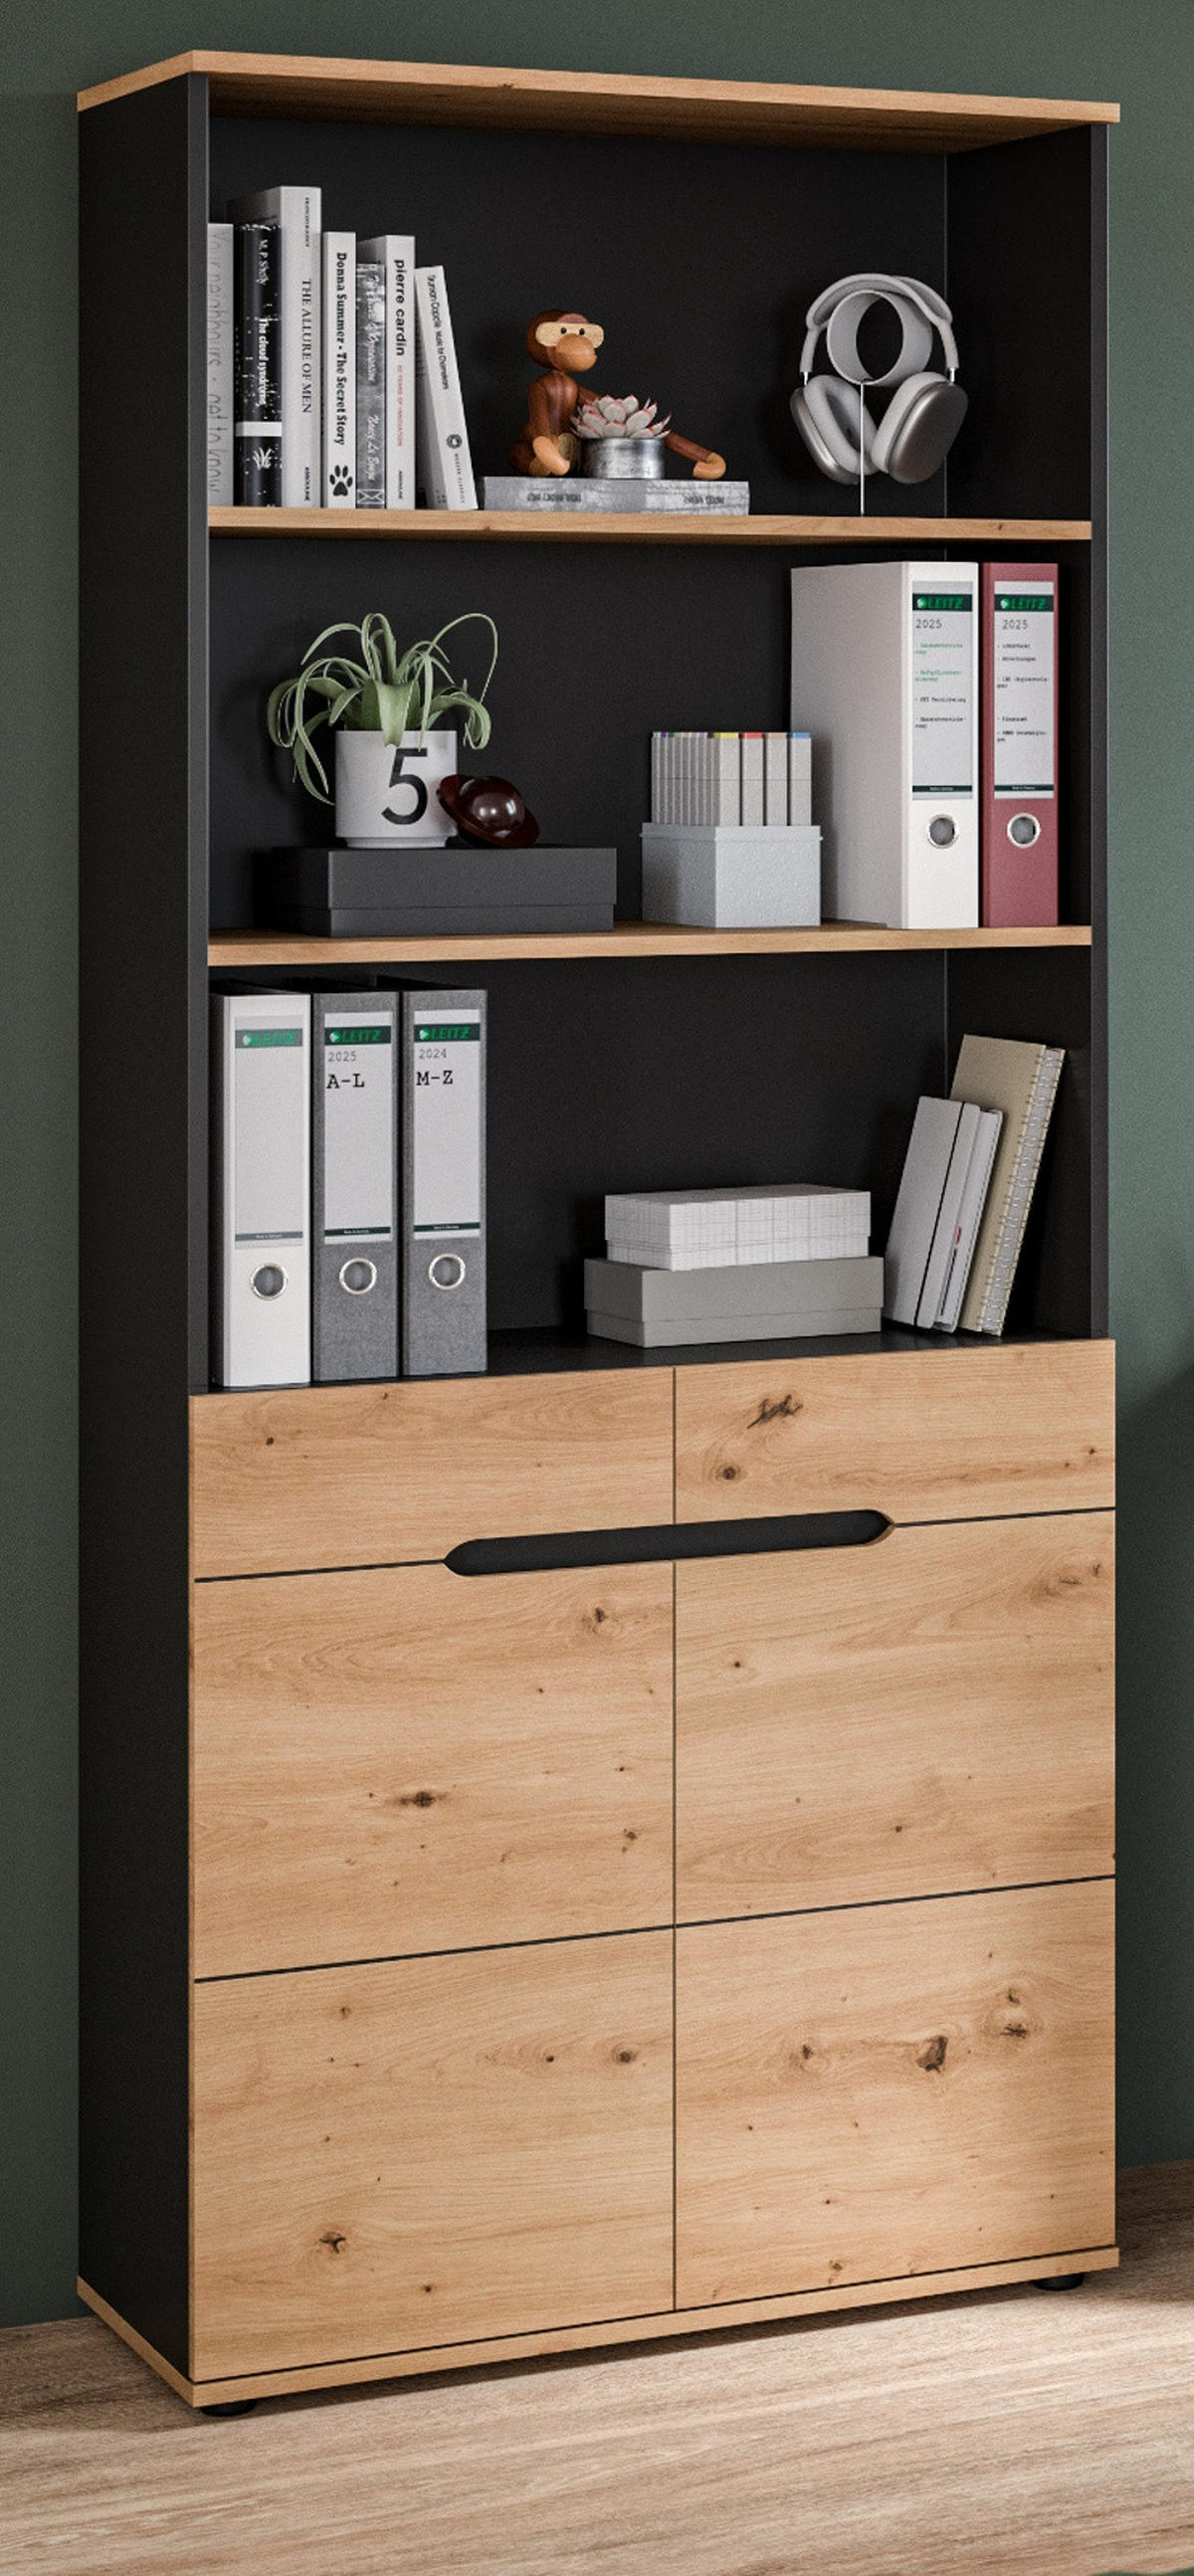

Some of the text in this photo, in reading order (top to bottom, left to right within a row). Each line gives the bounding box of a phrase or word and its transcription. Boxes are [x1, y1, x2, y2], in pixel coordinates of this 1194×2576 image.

[335, 252, 347, 292] Donna
[335, 294, 347, 343] Summer
[394, 259, 407, 356] pierre cardin
[259, 335, 270, 361] cloud
[301, 279, 311, 414] THE ALLURE OF MEN
[335, 351, 347, 375] The
[335, 376, 347, 414] Secret
[333, 415, 347, 446] Story
[914, 618, 943, 630] 2025
[1002, 619, 1029, 630] 2025
[381, 748, 428, 825] 5
[341, 1028, 382, 1043] LEITZ
[429, 1025, 471, 1040] LEITZ
[327, 1051, 357, 1063] 2025
[418, 1048, 448, 1060] 2024
[326, 1073, 365, 1090] A-L
[416, 1070, 454, 1087] M-Z
